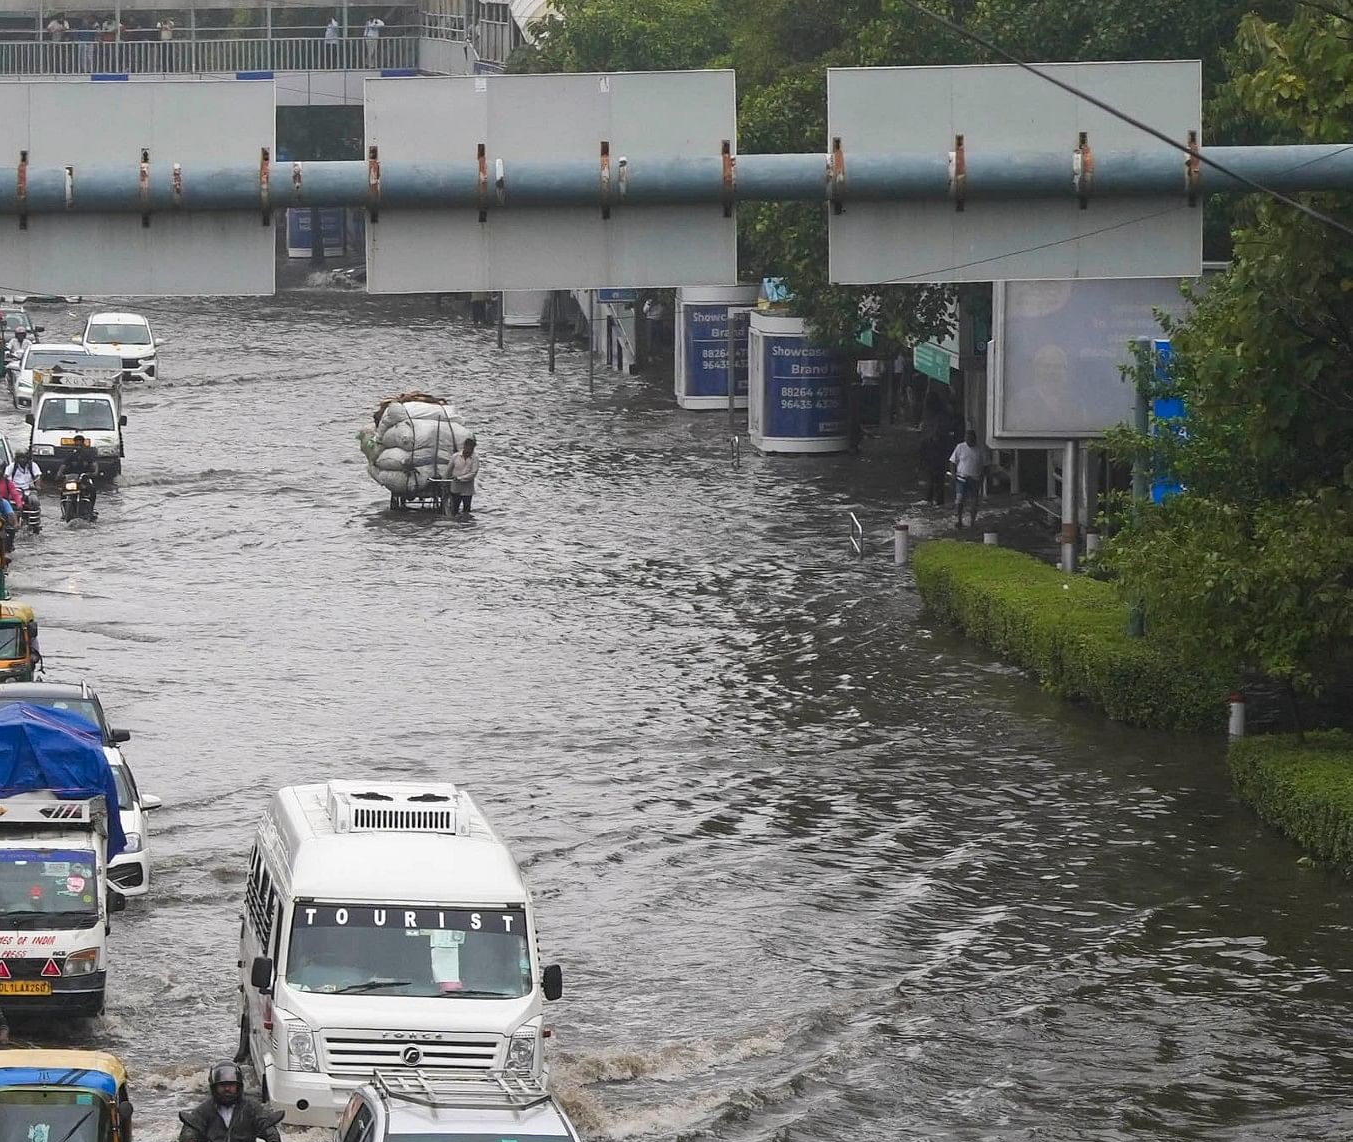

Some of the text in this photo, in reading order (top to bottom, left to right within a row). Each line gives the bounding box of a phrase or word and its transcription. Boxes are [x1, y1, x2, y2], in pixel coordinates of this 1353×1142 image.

[693, 312, 745, 322] Showcse
[711, 328, 744, 337] Brad
[772, 346, 826, 357] Showcas
[791, 364, 828, 375] Brand
[781, 387, 813, 397] 88264
[781, 400, 812, 410] 96435
[304, 908, 514, 932] TOURIST
[15, 935, 27, 945] OF
[31, 936, 56, 945] INDIA
[0, 950, 28, 958] PRESS
[382, 1032, 443, 1040] FORCE
